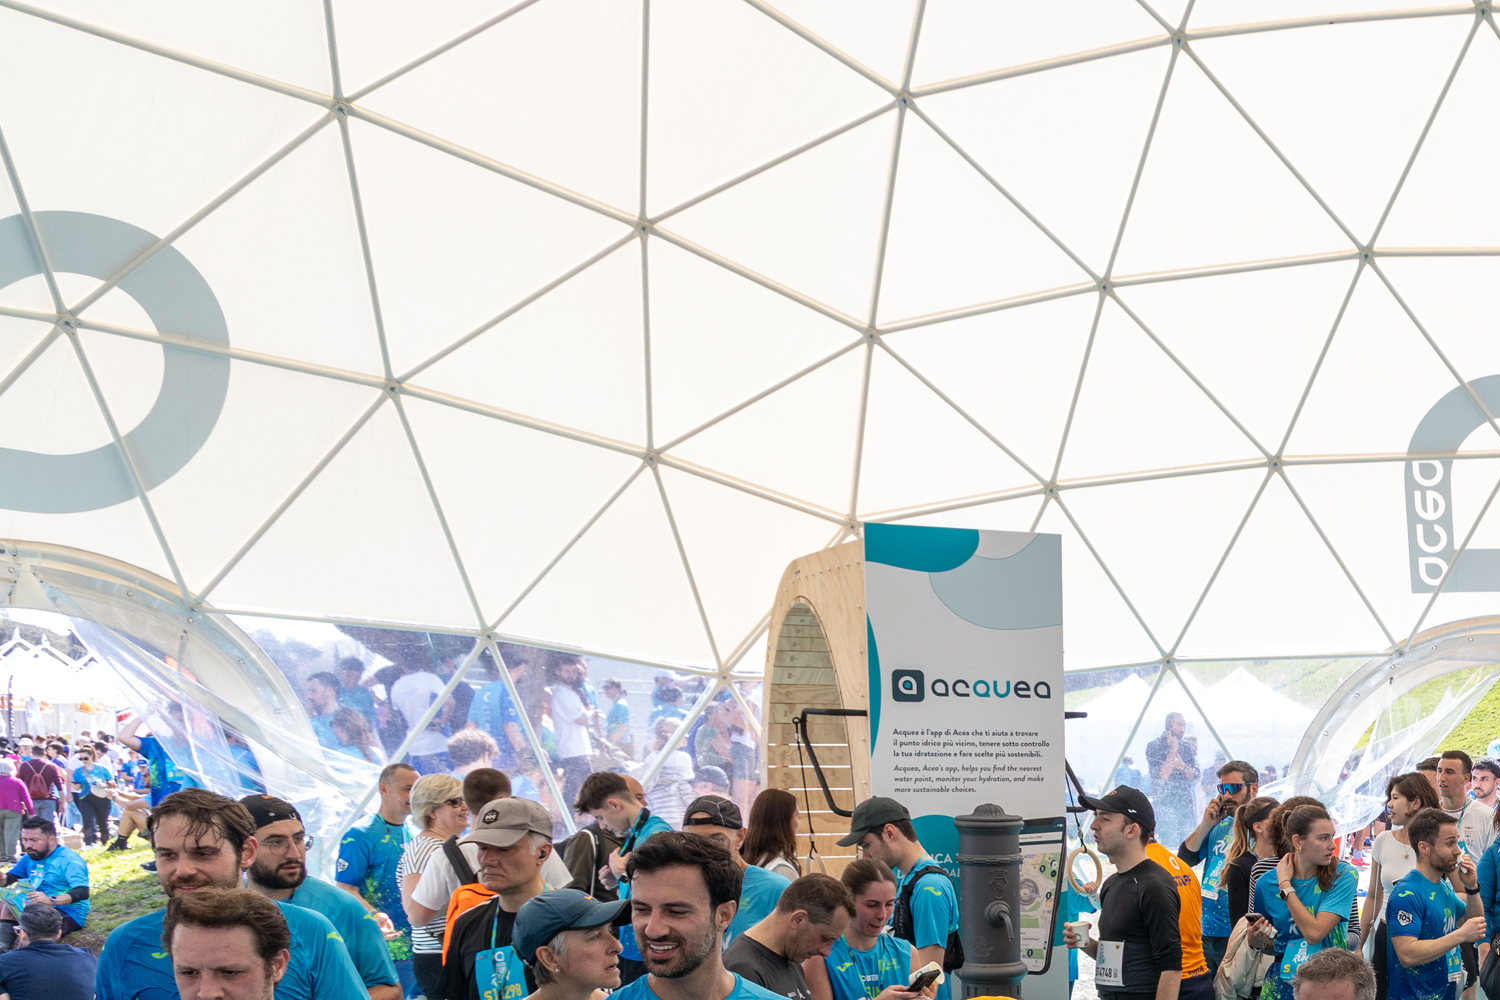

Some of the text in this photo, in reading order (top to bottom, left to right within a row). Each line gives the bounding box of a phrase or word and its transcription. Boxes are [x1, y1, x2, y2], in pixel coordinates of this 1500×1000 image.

[931, 679, 1051, 699] acquea
[893, 728, 919, 738] Acquea
[972, 729, 984, 737] che
[899, 740, 920, 748] punto
[942, 740, 954, 748] più
[955, 740, 978, 748] vicino,
[995, 750, 1006, 760] più
[893, 764, 922, 774] Acquea,
[945, 766, 960, 774] app,
[962, 764, 978, 774] helps
[992, 764, 1006, 774] find
[914, 775, 934, 784] point,
[962, 776, 977, 784] your
[978, 774, 1012, 784] hydration,
